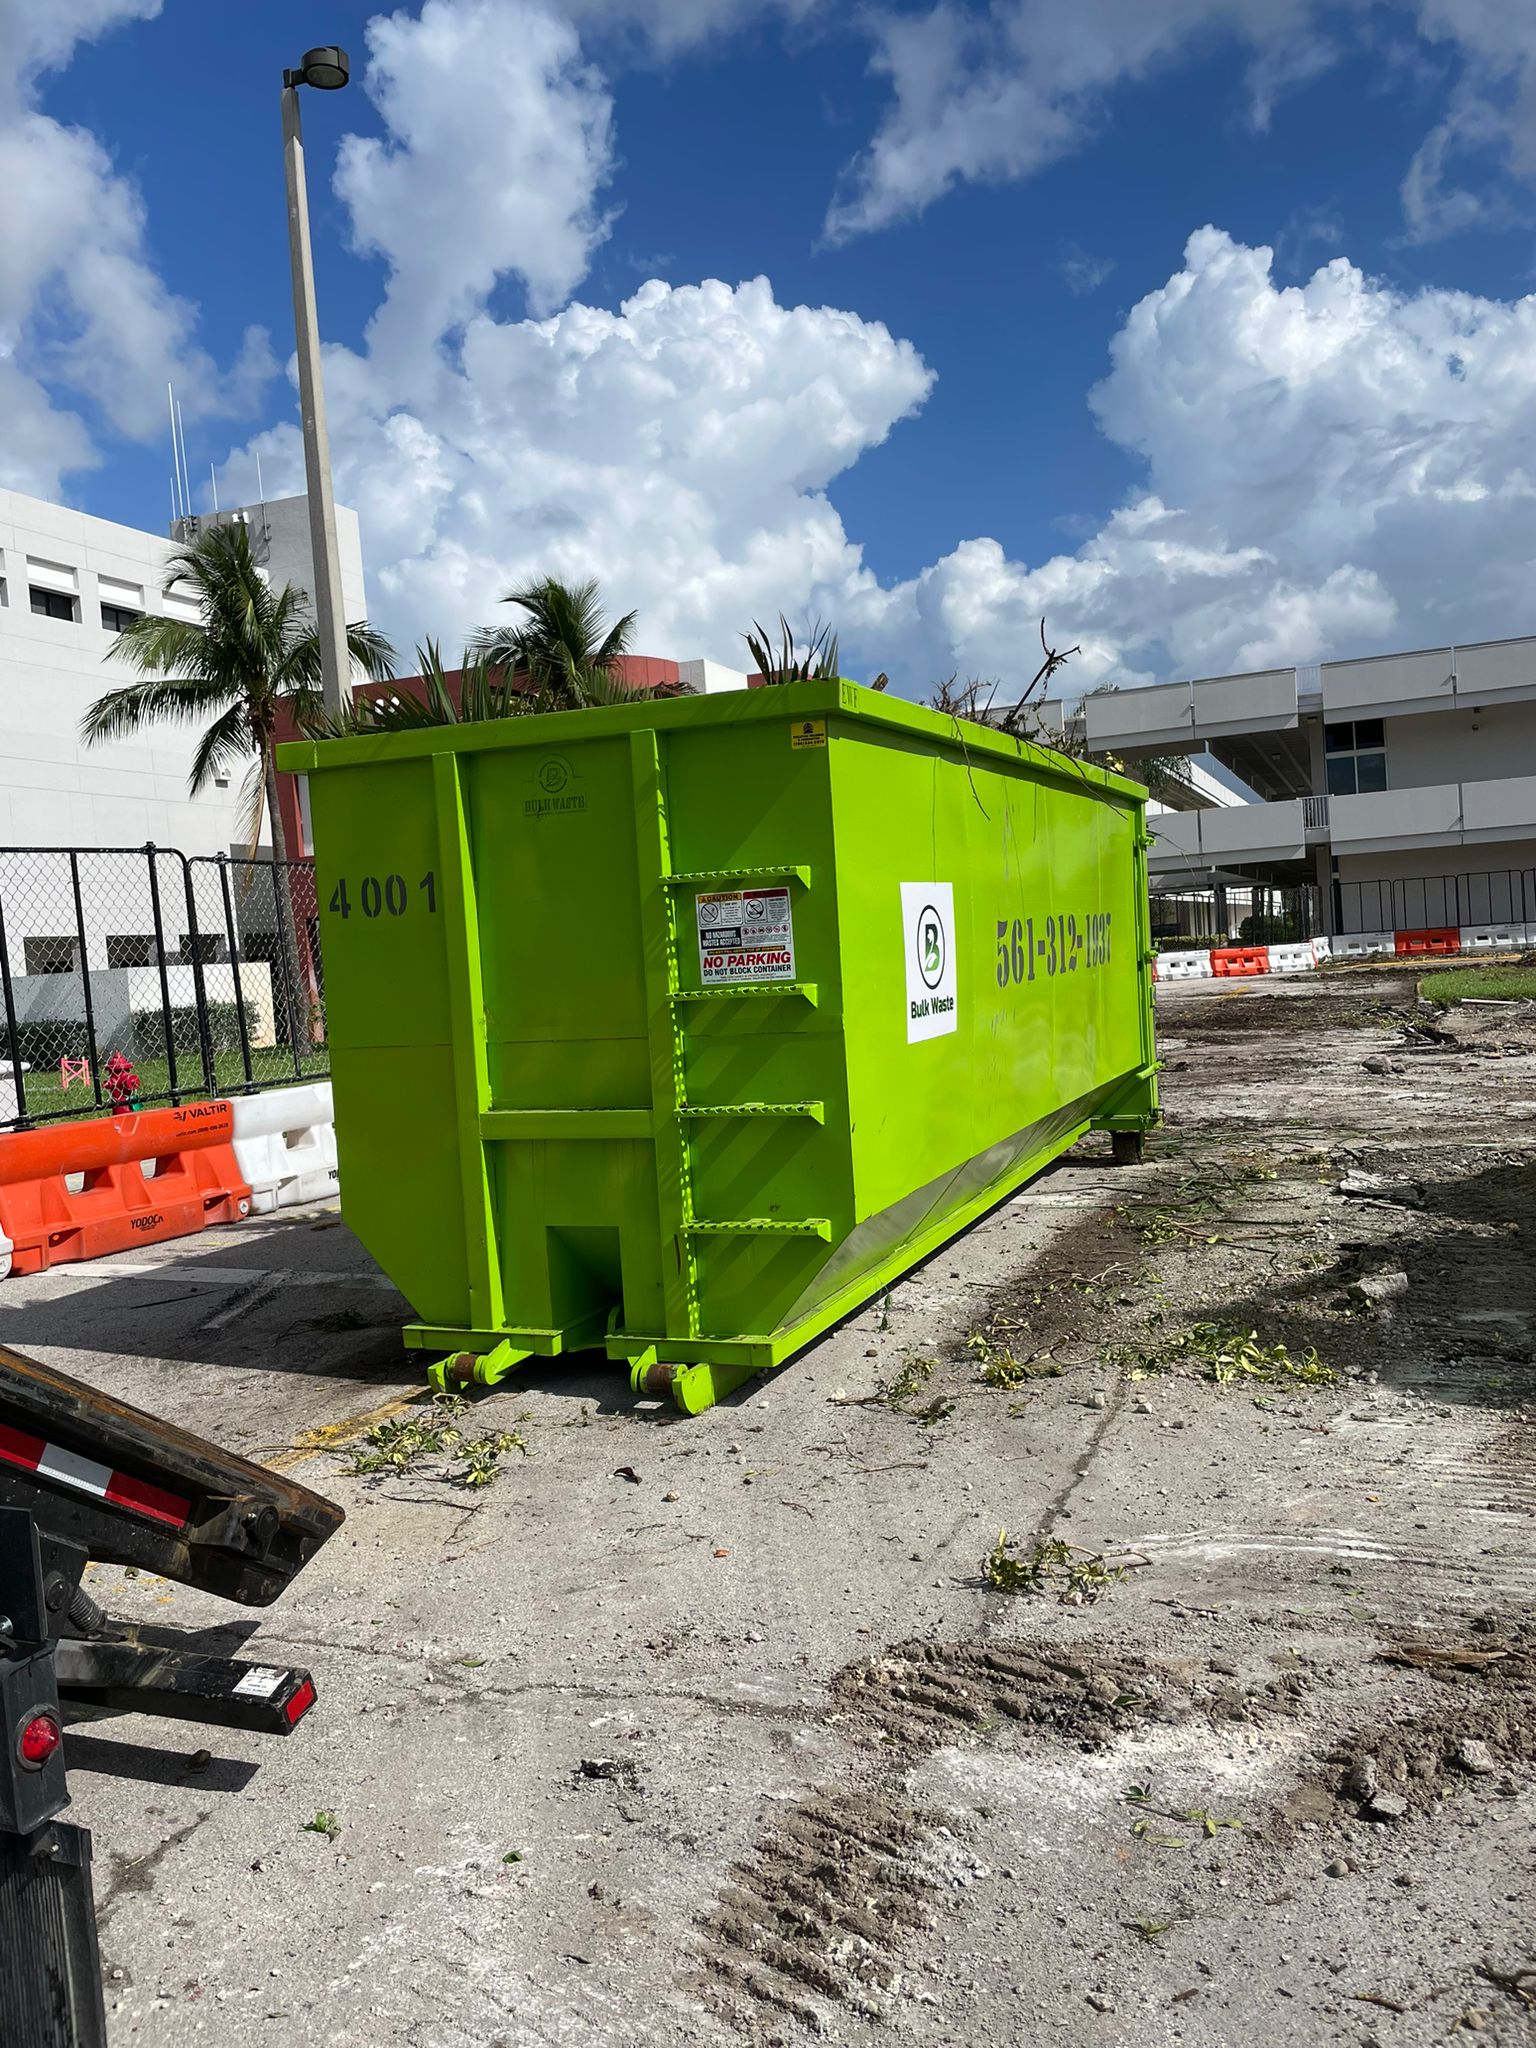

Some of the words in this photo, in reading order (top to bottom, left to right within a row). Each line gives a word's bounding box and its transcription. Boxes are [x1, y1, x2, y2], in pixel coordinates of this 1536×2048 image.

[329, 871, 436, 919] 4001
[706, 894, 738, 902] CAUTION
[997, 912, 1111, 988] 561-312-1937
[704, 956, 723, 968] NO
[727, 951, 791, 967] PARKING
[730, 966, 752, 974] BLOCK
[753, 964, 792, 973] CONTAINER
[911, 999, 930, 1019] Bulk
[930, 995, 954, 1014] Waste
[189, 1104, 227, 1118] VALTIR
